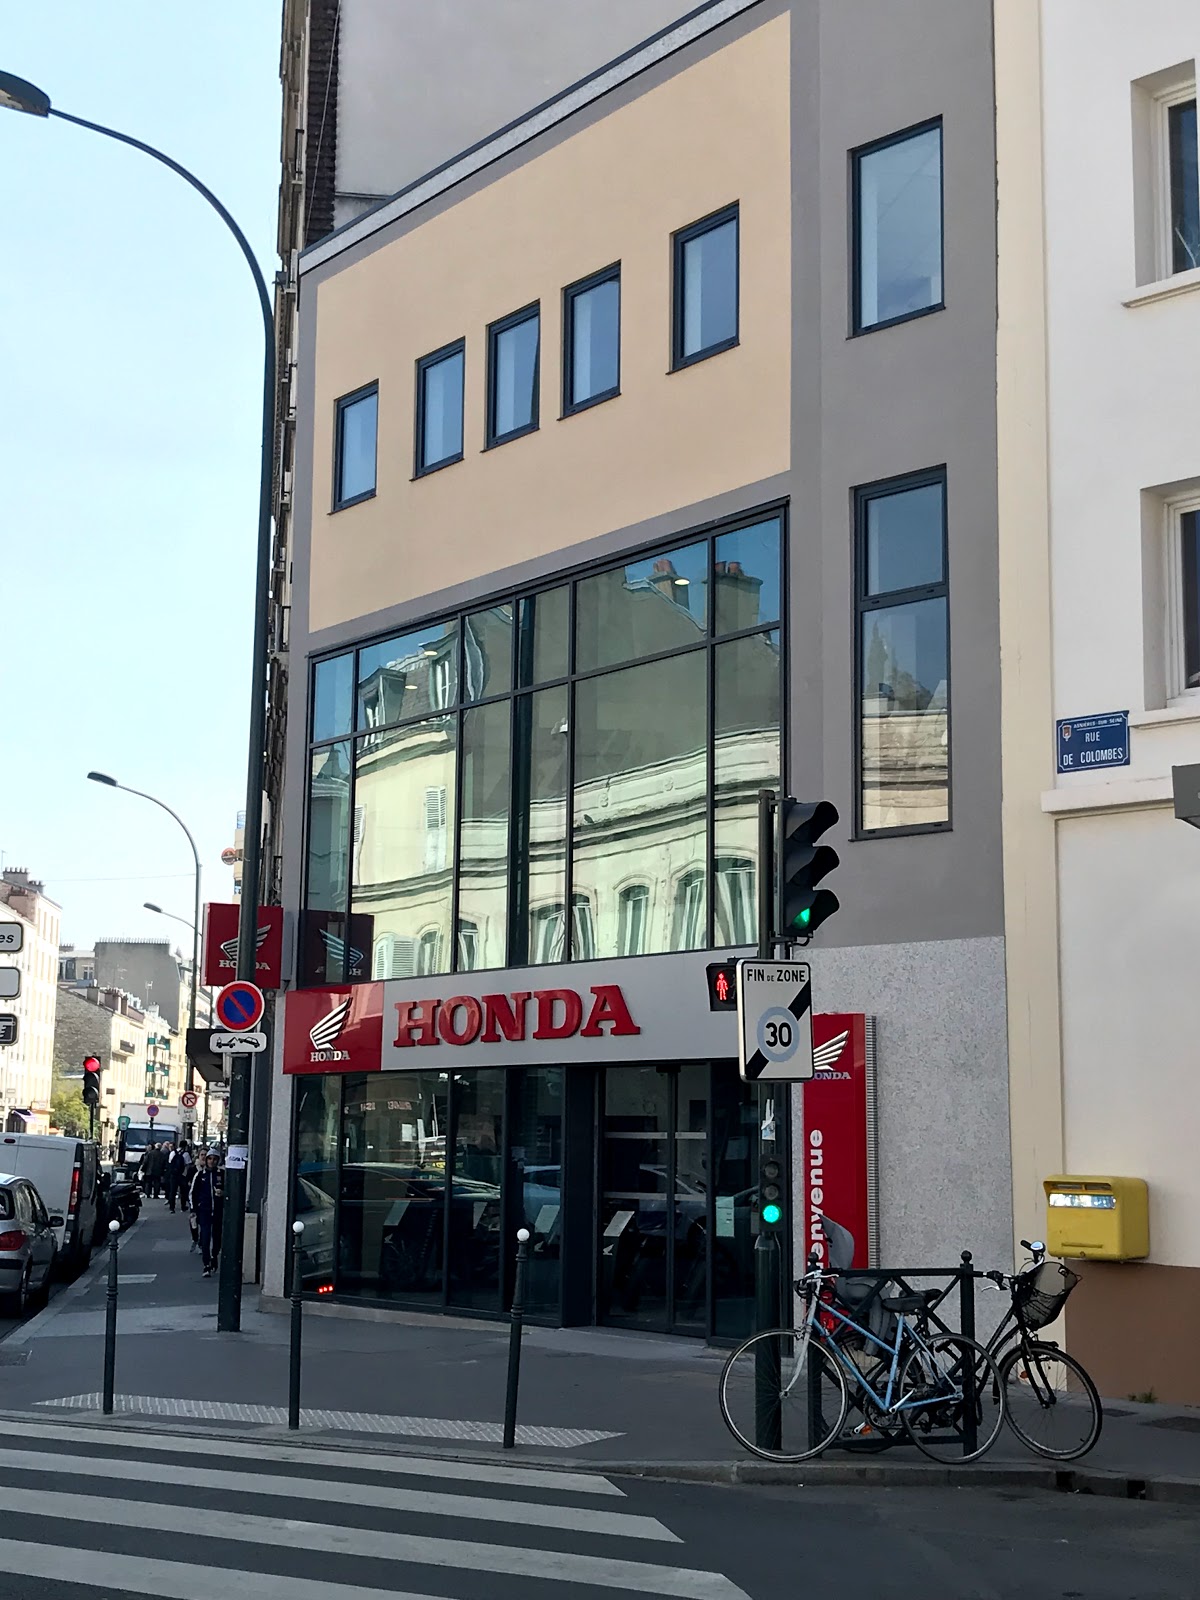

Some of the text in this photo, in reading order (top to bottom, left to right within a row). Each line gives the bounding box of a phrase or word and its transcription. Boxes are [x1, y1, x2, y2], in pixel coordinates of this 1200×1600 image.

[1085, 731, 1100, 742] RUE
[1063, 747, 1123, 766] DE COLOMBES
[746, 968, 765, 982] FIN
[776, 969, 806, 982] ZONE
[393, 984, 641, 1048] HONDA
[765, 1022, 792, 1047] 30
[310, 1050, 351, 1062] HONDA
[812, 1071, 852, 1080] ONDA
